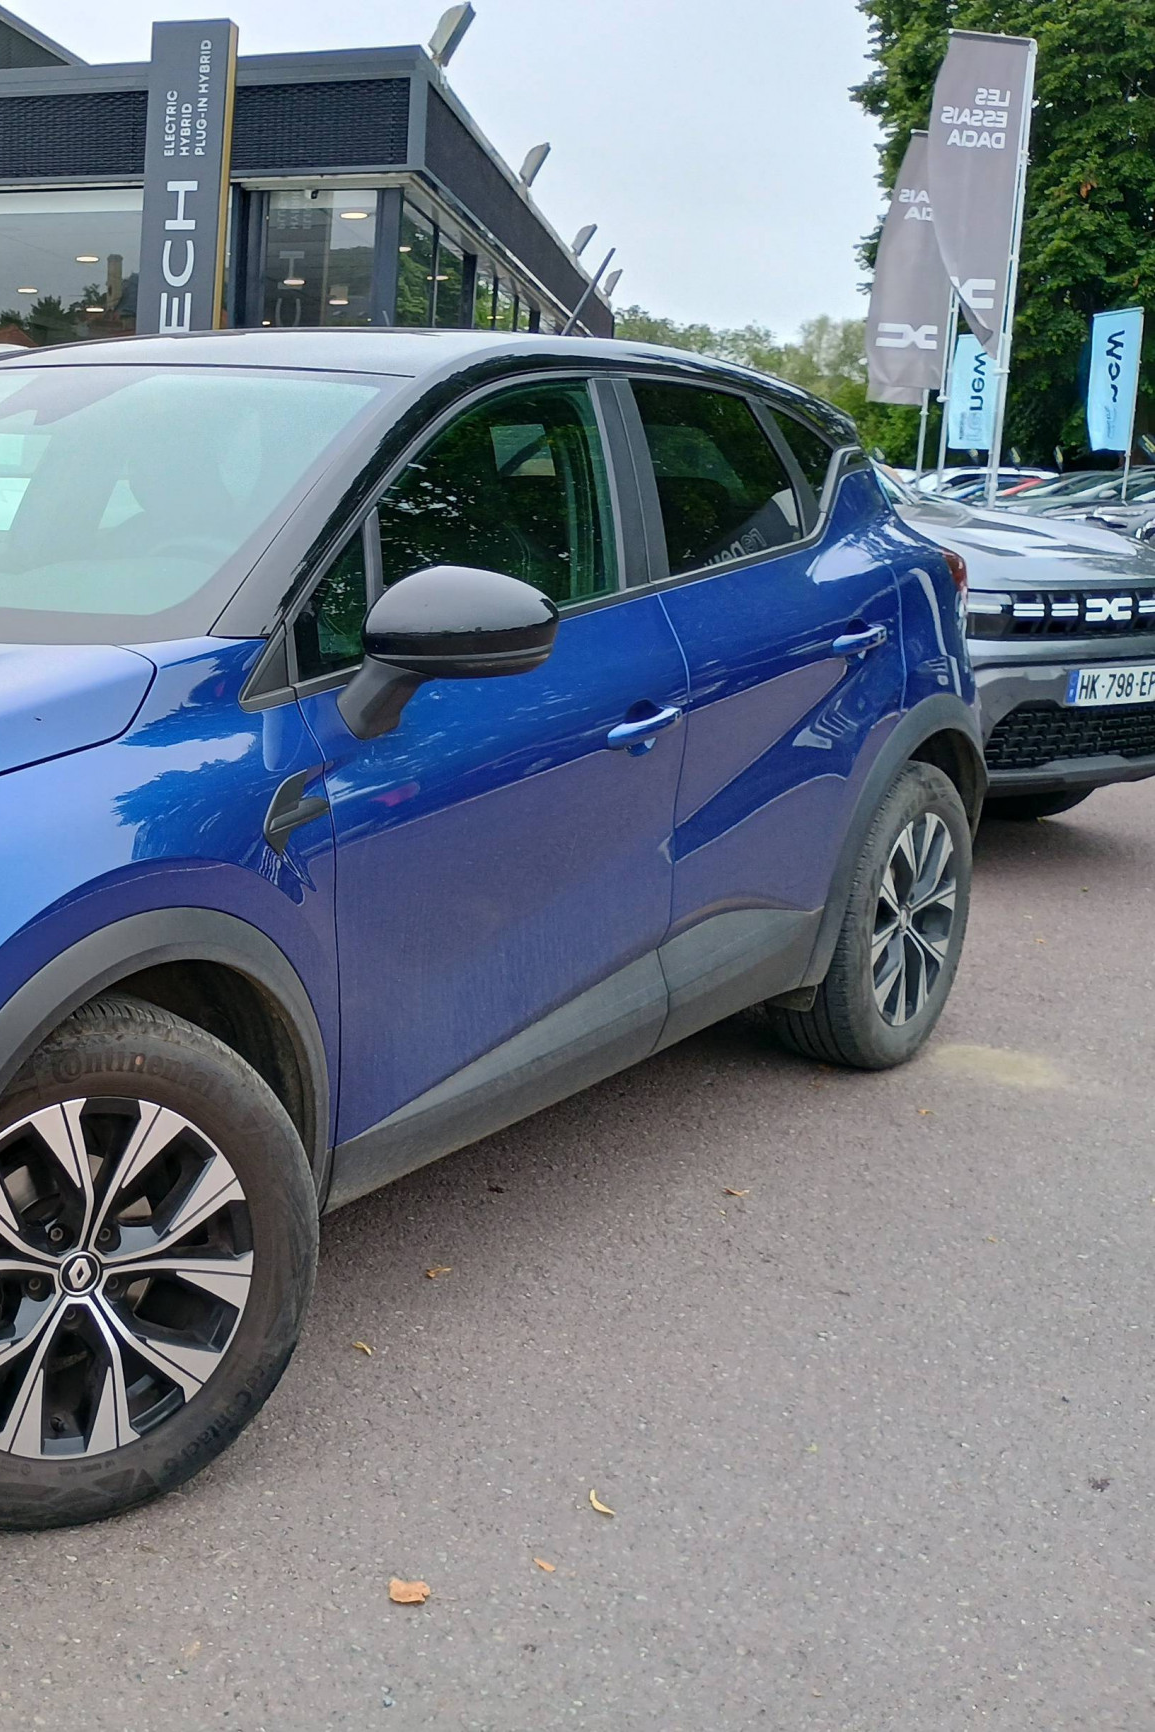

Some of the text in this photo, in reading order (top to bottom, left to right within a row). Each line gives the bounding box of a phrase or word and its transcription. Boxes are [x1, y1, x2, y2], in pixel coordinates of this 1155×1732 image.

[163, 90, 178, 157] ELECTRIC
[179, 103, 193, 156] HYBRID
[194, 39, 212, 156] PLUG-IN HYBRID
